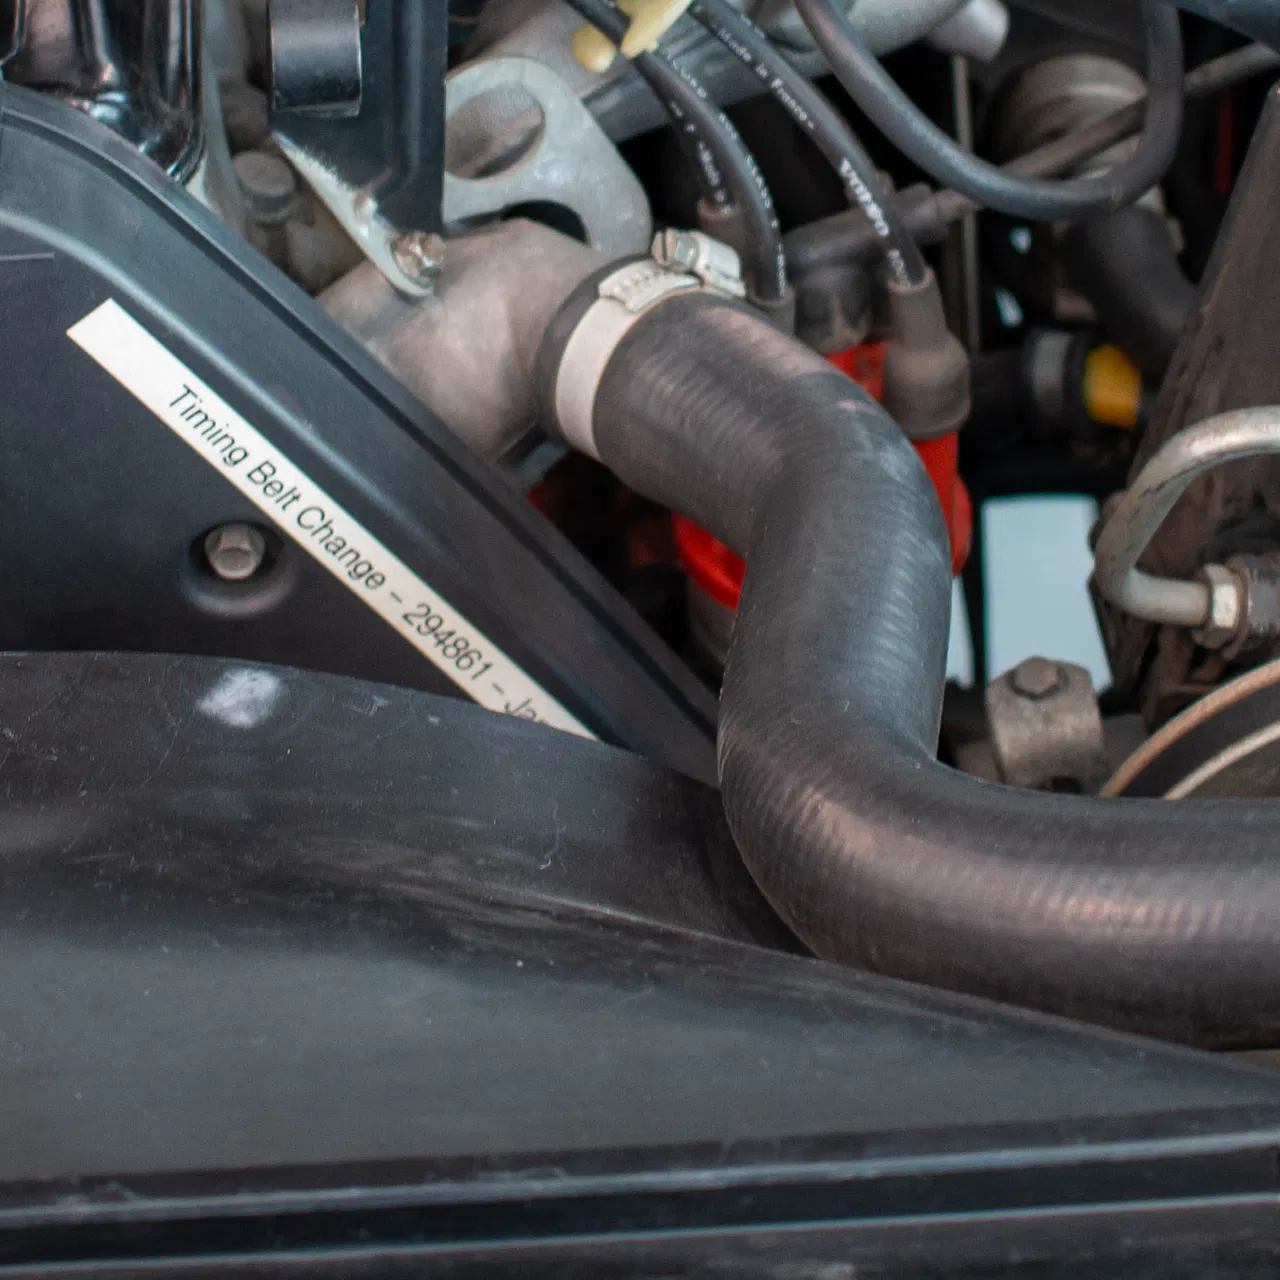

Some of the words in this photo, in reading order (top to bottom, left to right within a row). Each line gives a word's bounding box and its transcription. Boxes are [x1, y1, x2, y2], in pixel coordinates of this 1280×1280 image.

[169, 383, 249, 467] Timing
[247, 460, 301, 511] Belt
[296, 506, 386, 590] Change
[402, 603, 494, 680] 294861
